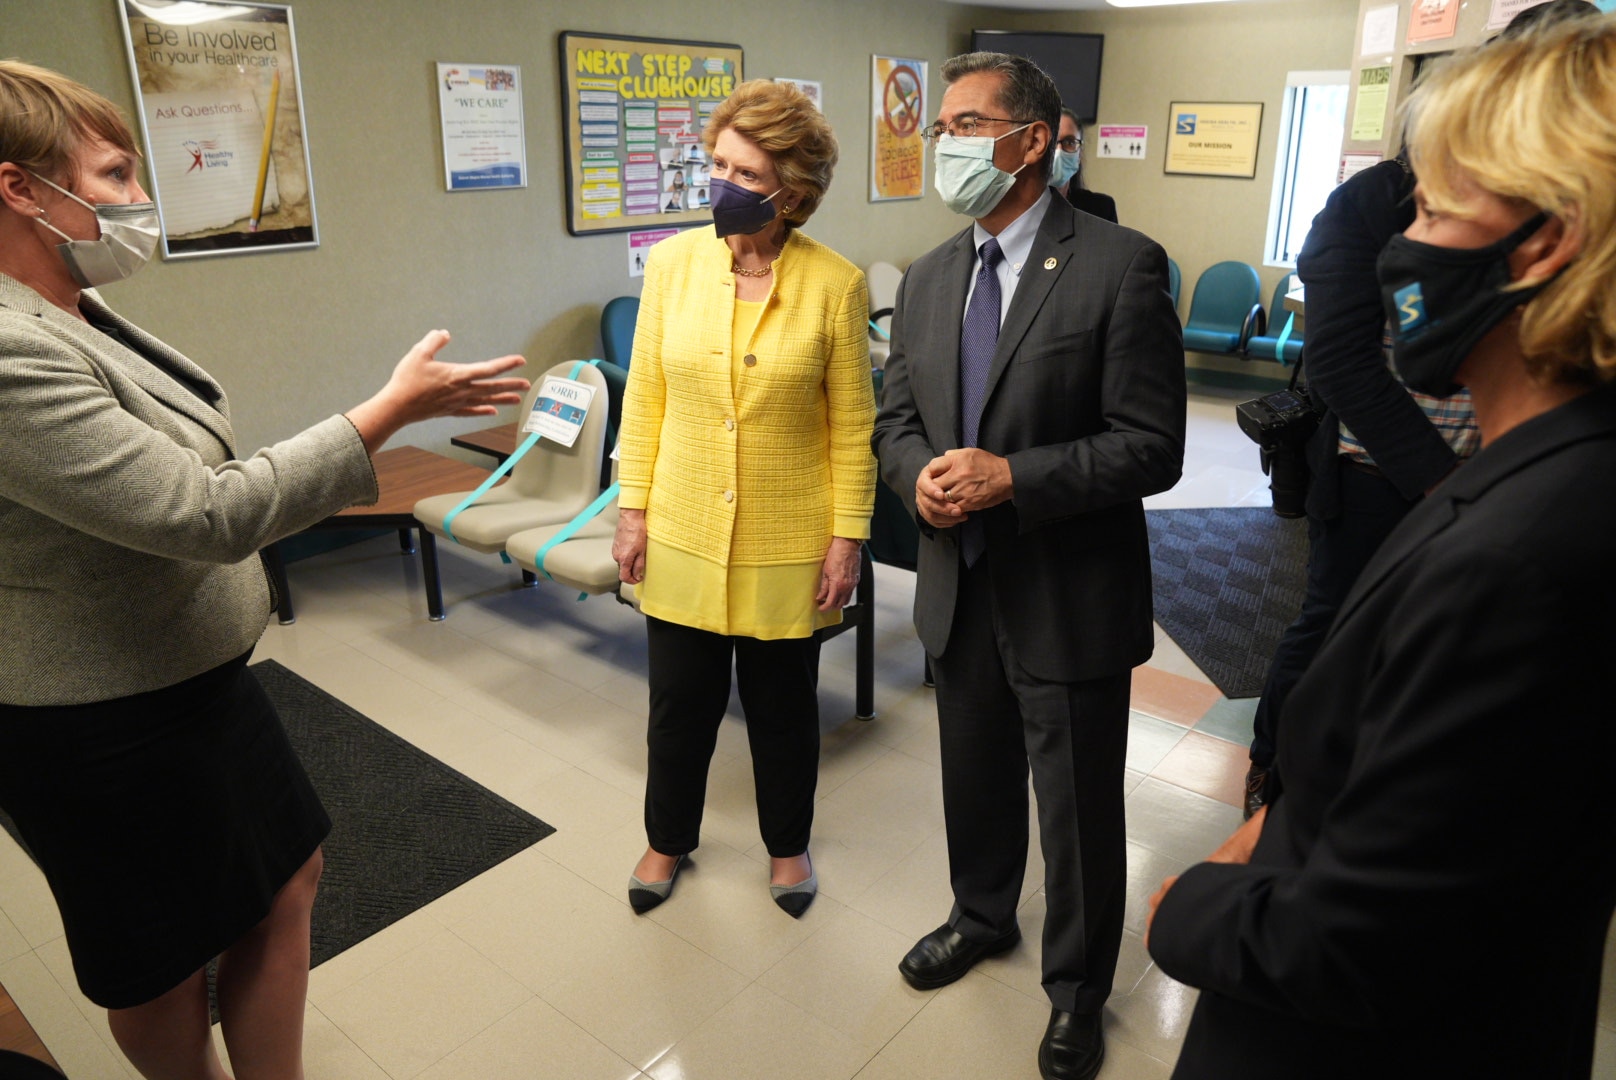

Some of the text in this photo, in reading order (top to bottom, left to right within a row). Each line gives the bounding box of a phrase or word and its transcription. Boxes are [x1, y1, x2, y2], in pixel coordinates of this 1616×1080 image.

[144, 22, 277, 51] Be Involved
[150, 49, 279, 67] in your Healthcare
[576, 49, 631, 75] NEXT
[642, 53, 692, 77] STEP
[1360, 68, 1390, 86] MAPS
[618, 75, 733, 99] CLUBHOUSE
[155, 103, 253, 119] Ask Questions...
[477, 98, 508, 109] CARE"
[204, 150, 233, 160] Healthy
[880, 145, 918, 161] Tobacco
[206, 160, 229, 169] Living
[881, 157, 919, 187] FREE
[551, 385, 579, 401] SORRY
